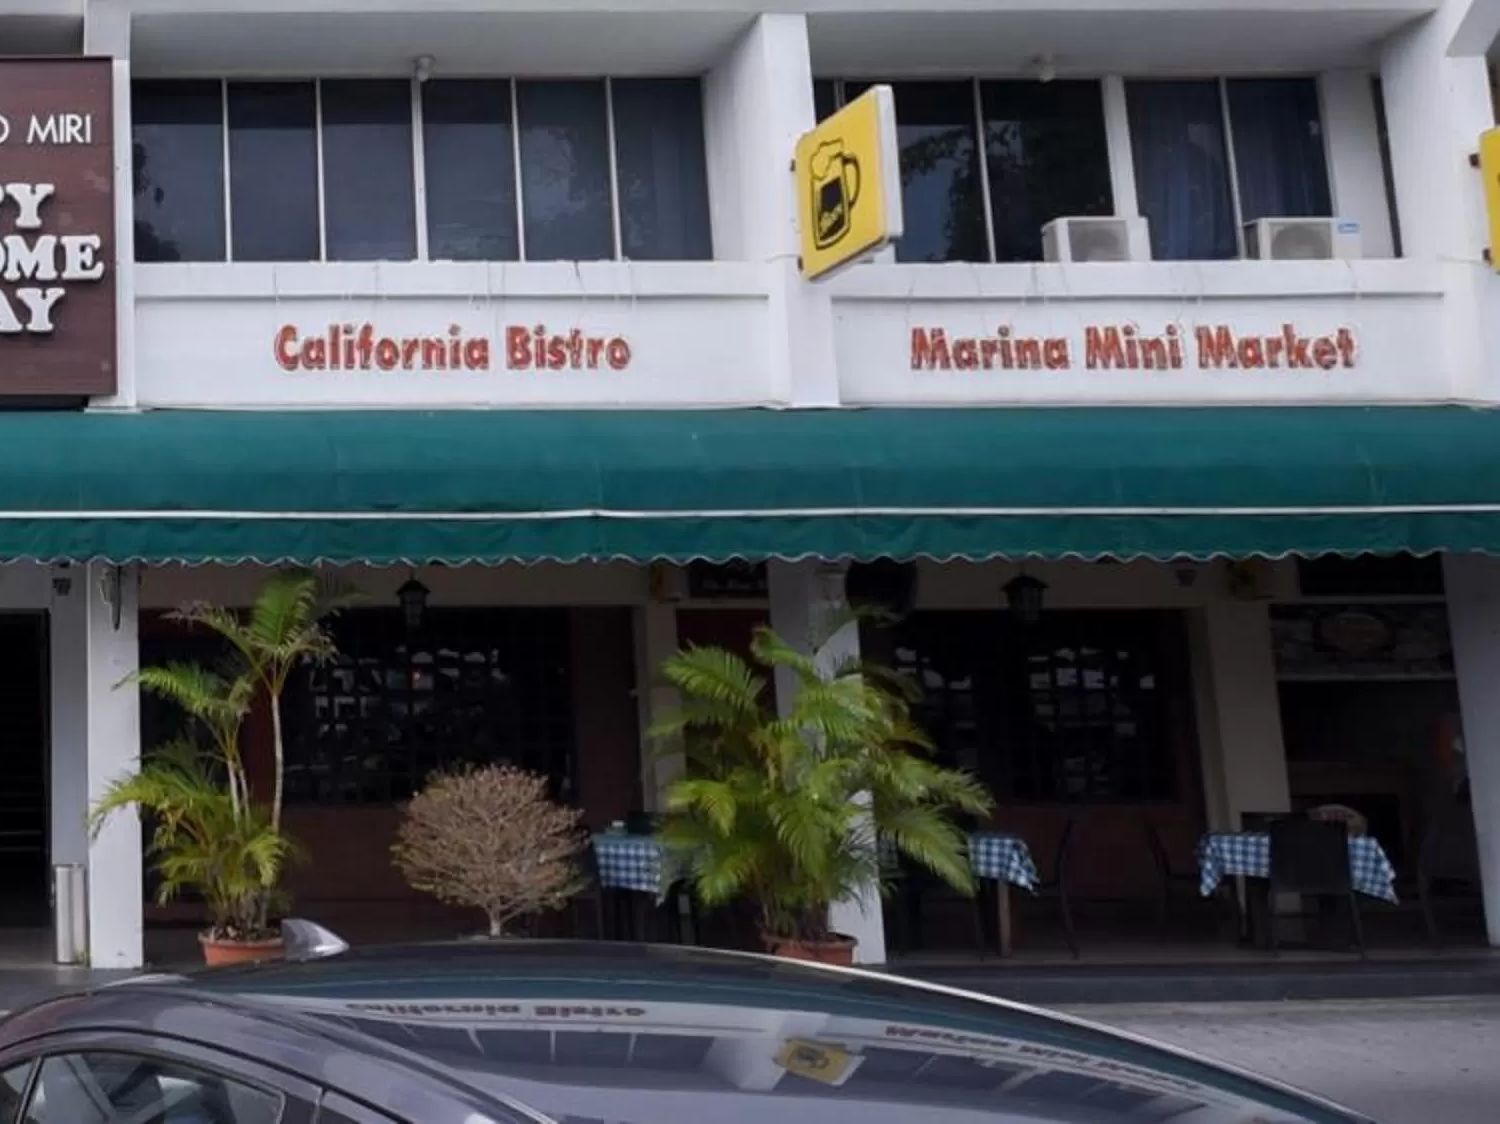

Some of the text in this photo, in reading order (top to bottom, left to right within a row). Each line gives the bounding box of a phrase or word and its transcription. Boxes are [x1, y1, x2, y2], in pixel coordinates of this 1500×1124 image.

[27, 113, 92, 144] MIRI
[273, 322, 632, 371] California Bistro
[909, 323, 1357, 371] Marina Mini Market
